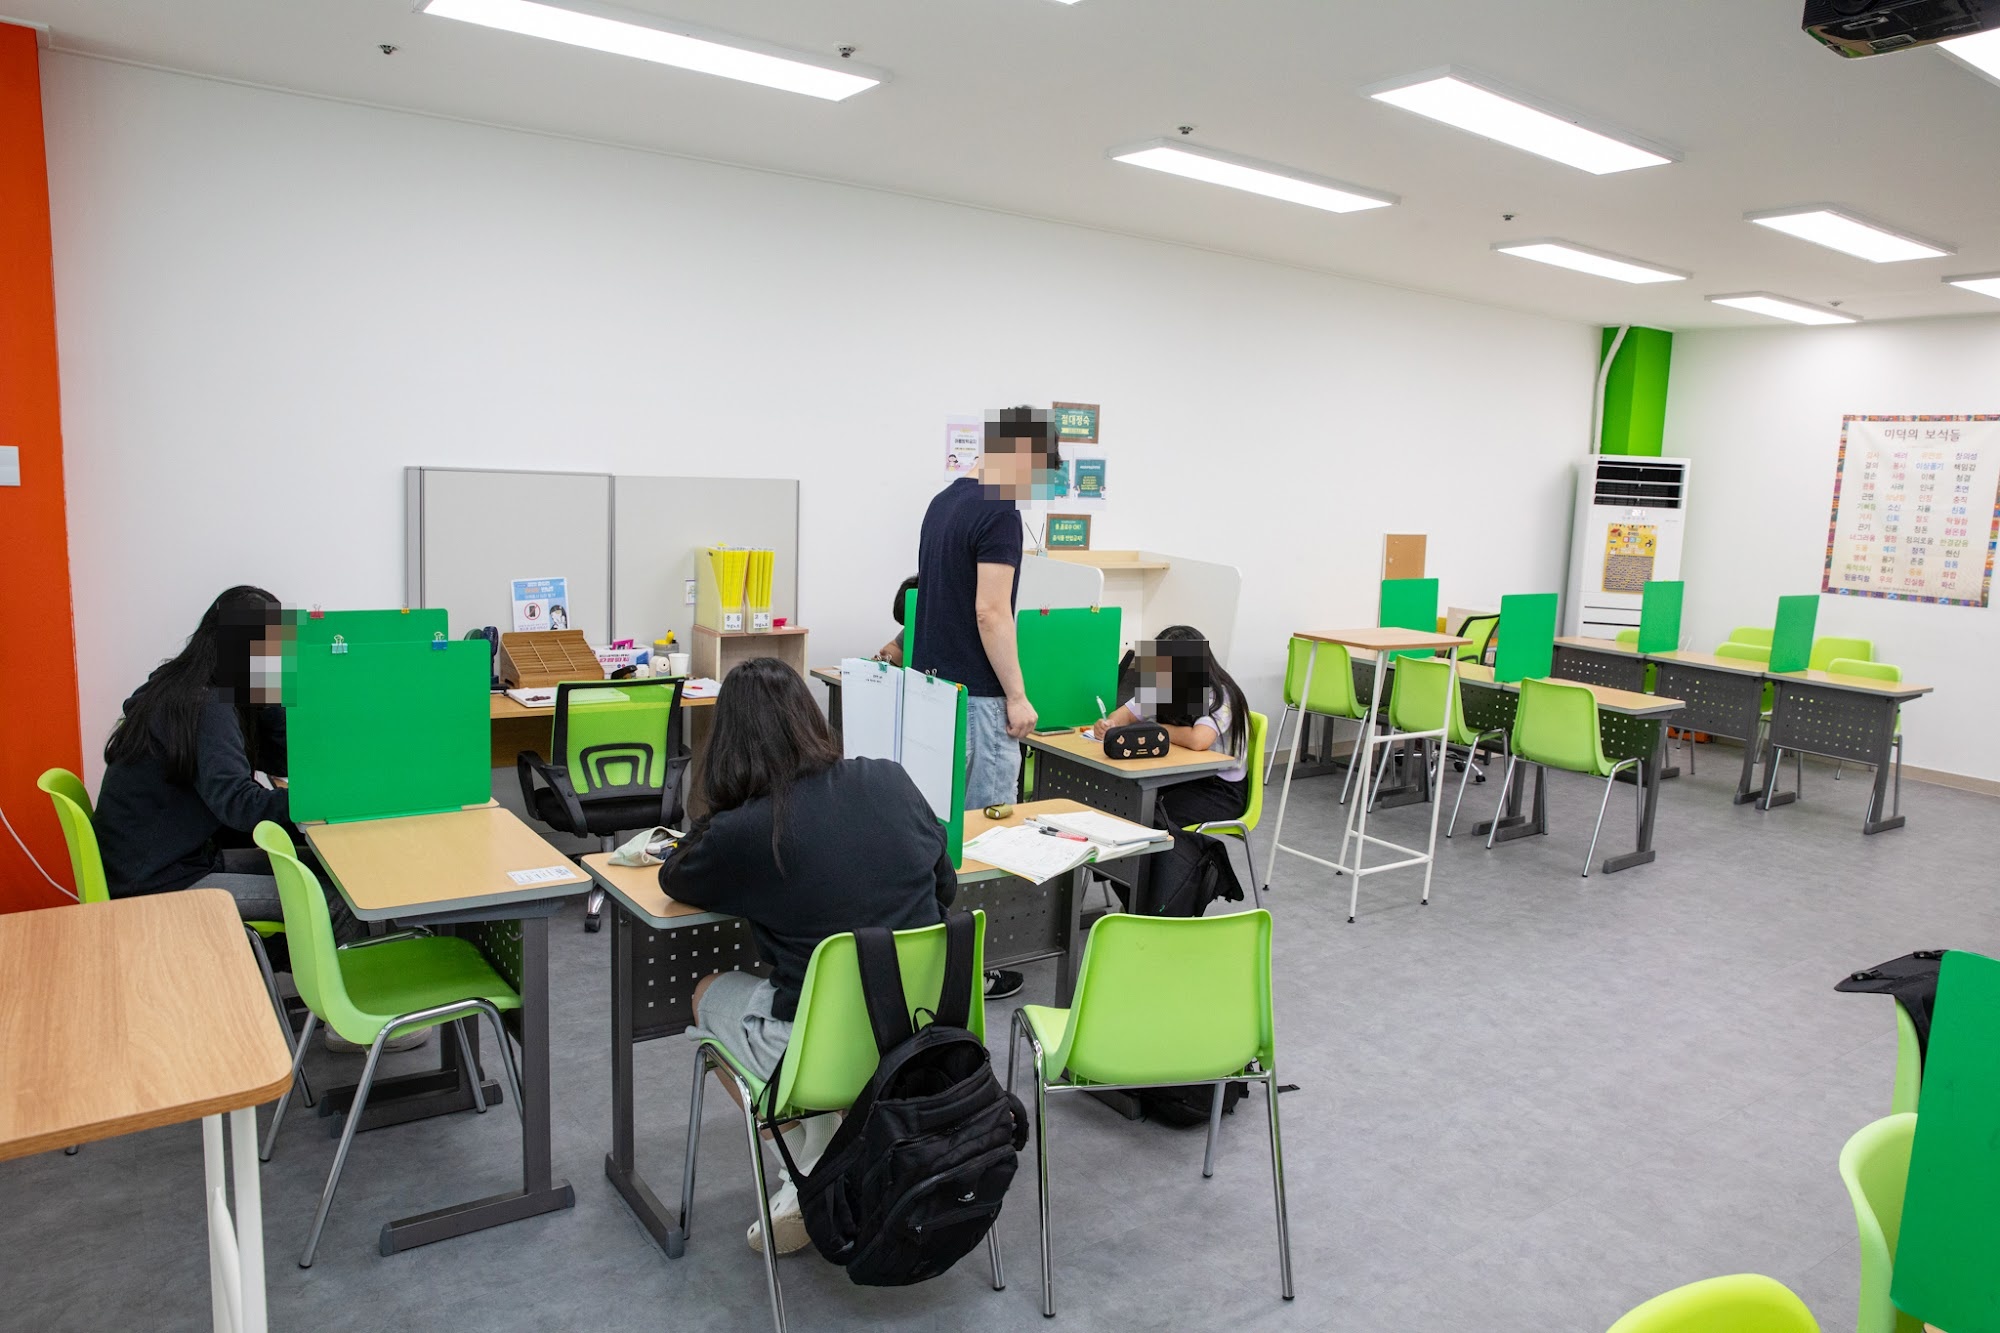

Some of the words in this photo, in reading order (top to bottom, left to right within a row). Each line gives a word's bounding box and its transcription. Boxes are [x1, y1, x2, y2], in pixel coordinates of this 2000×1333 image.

[1061, 415, 1090, 426] 절대정숙
[1885, 429, 1917, 440] 미덕의
[1926, 429, 1960, 442] 보석들
[1955, 452, 1977, 460] 창의성
